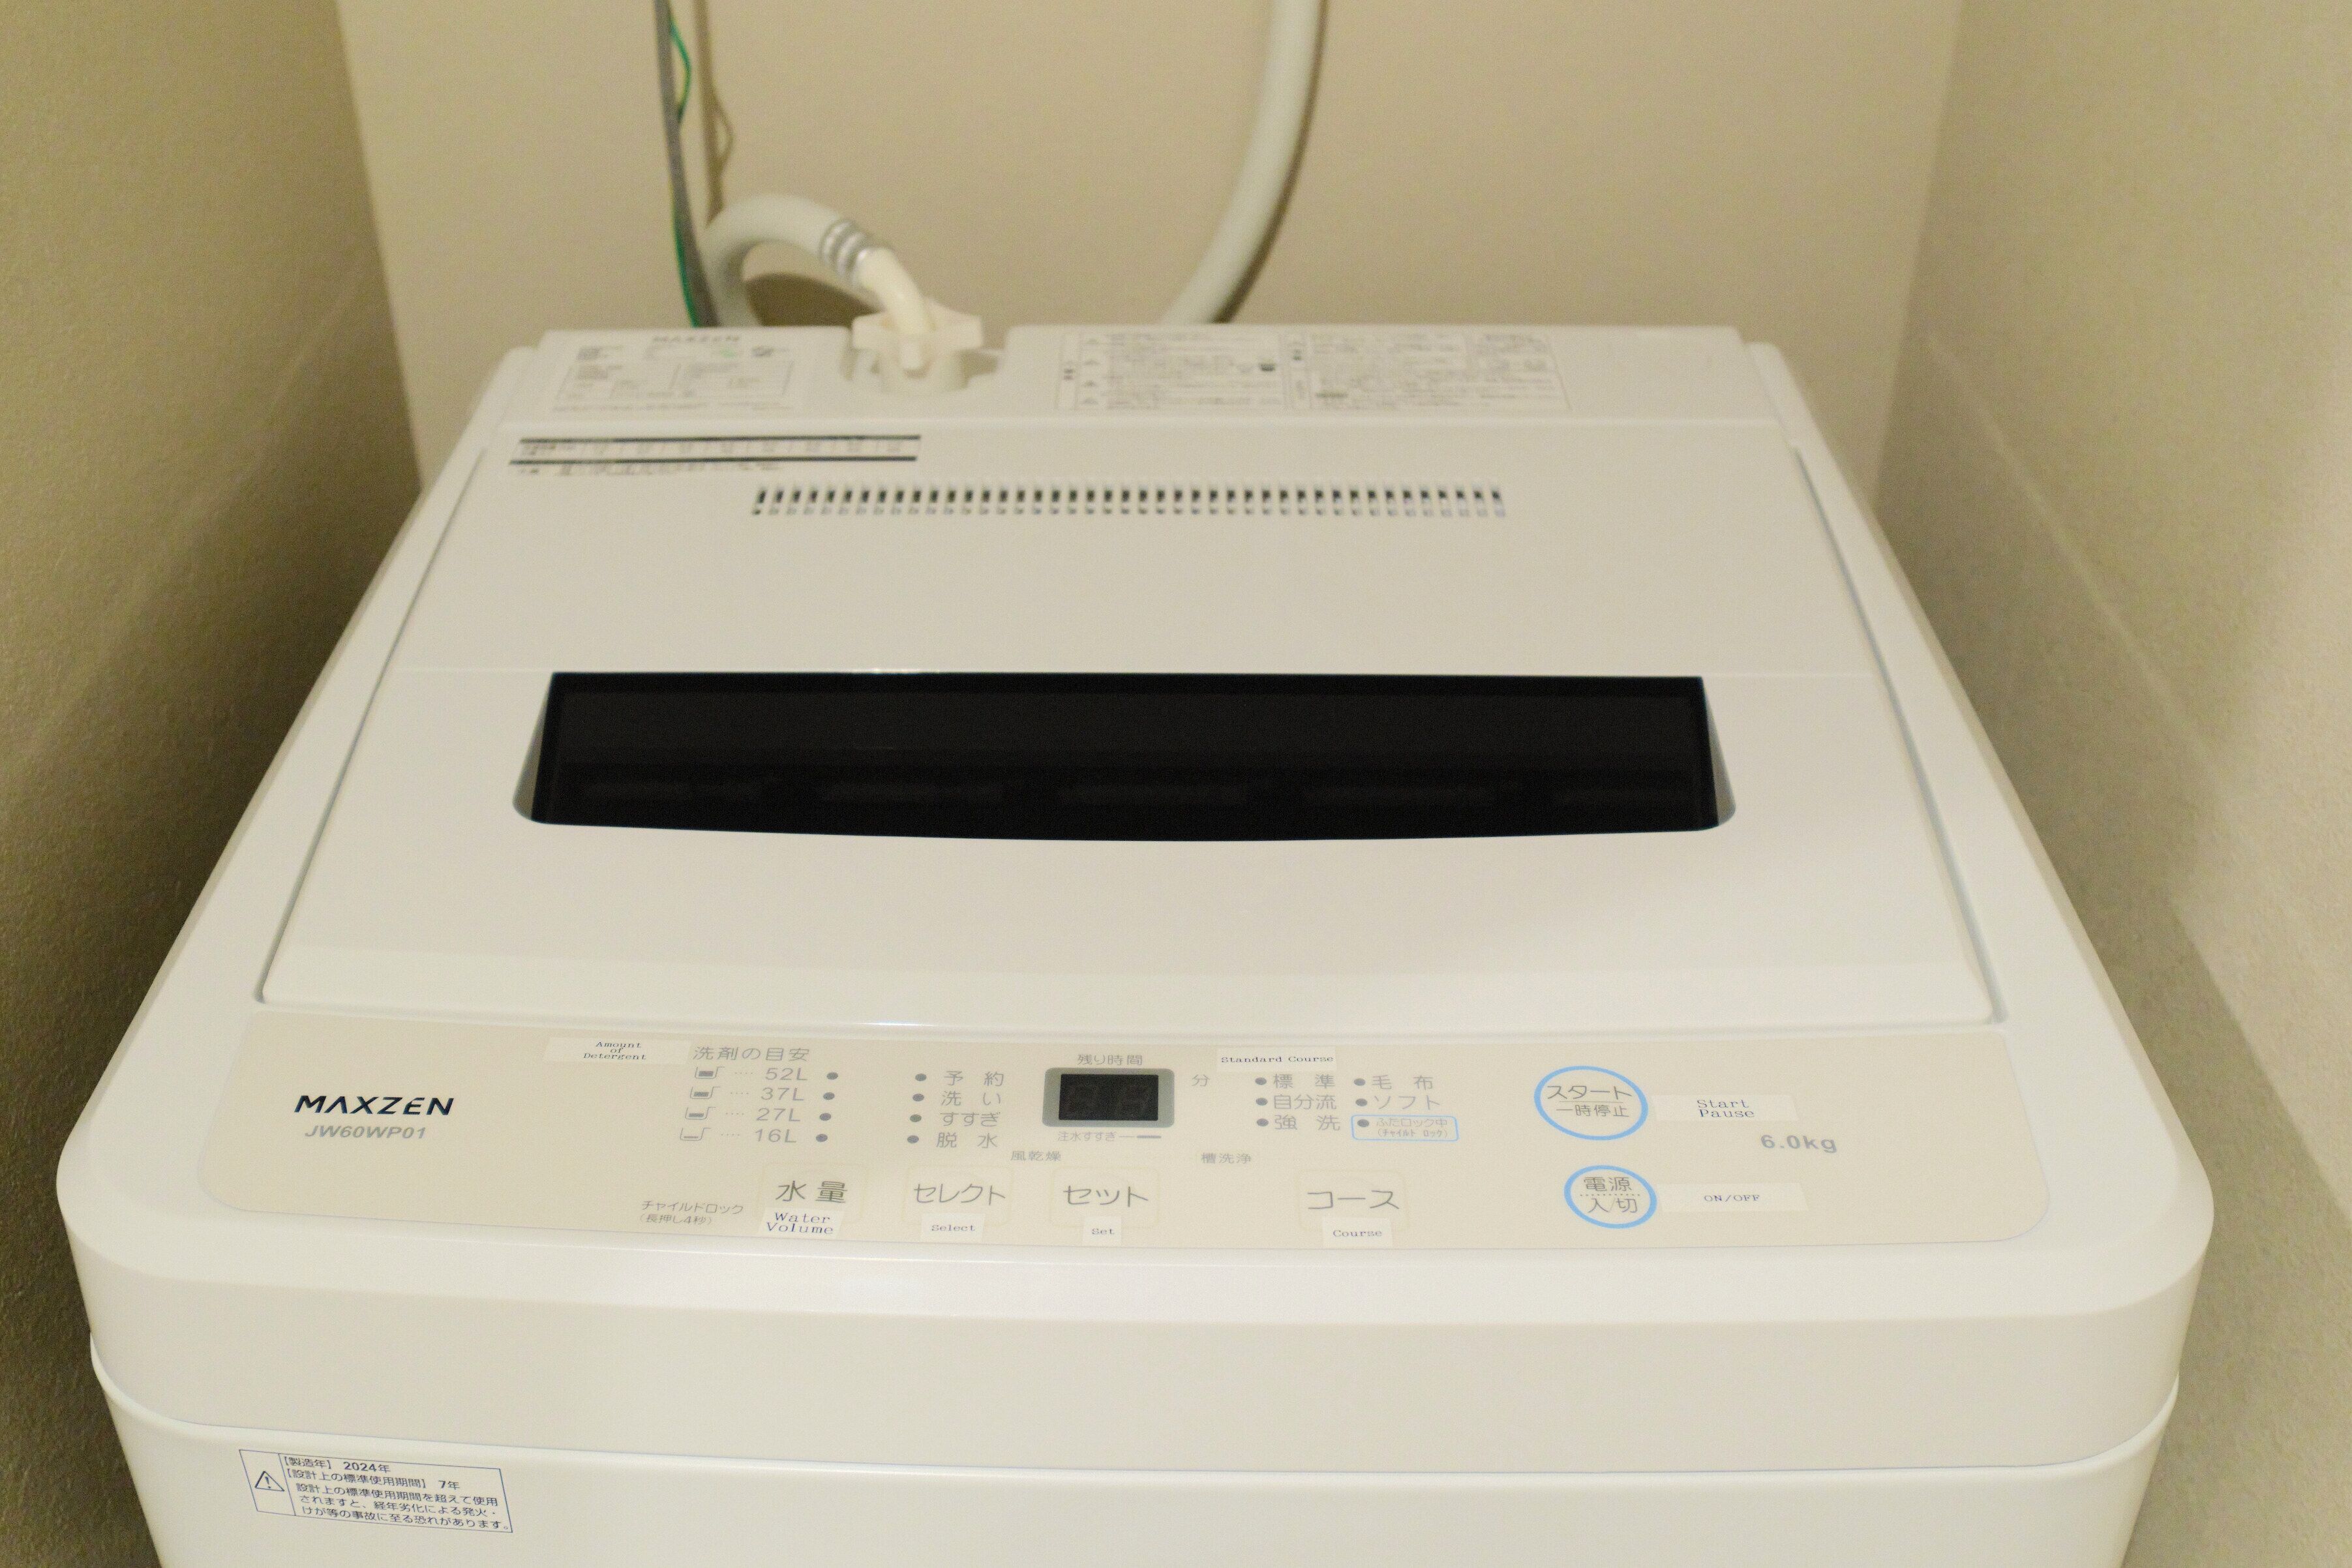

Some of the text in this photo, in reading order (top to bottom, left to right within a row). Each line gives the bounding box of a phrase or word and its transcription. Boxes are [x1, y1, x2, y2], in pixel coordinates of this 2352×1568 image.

[693, 1046, 810, 1062] 洗剤の目安
[1078, 1054, 1143, 1065] 残り時間
[765, 1068, 809, 1081] 52L
[1192, 1074, 1209, 1087] 分
[760, 1087, 805, 1101] 37L
[1546, 1085, 1632, 1100] スタート
[294, 1094, 454, 1115] MAXZEN
[1273, 1094, 1337, 1109] 自分流
[1373, 1095, 1440, 1109] ソフト
[1697, 1099, 1749, 1108] Start
[756, 1108, 802, 1122] 27L
[1556, 1104, 1629, 1117] 一時停止
[1698, 1109, 1755, 1119] Pause
[941, 1111, 1000, 1126] すすぎ
[1376, 1118, 1447, 1127] ふたロック中
[305, 1124, 426, 1139] JW60WP01
[753, 1129, 798, 1143] 16L
[1057, 1131, 1117, 1141] 注水すすぎ
[1760, 1135, 1837, 1153] 6.0kg
[1010, 1150, 1062, 1162] 風乾燥
[1201, 1153, 1252, 1164] 槽洗浄
[1583, 1176, 1632, 1192] 電源
[914, 1183, 1006, 1205] セレクト
[1063, 1184, 1148, 1207] セット
[1307, 1190, 1400, 1211] コース
[1704, 1194, 1760, 1203] ON/OFF
[642, 1200, 743, 1214] チャイルドロック
[774, 1211, 830, 1224] Water
[766, 1222, 834, 1234] Volume
[931, 1223, 975, 1231] Select
[1091, 1226, 1115, 1235] Set
[344, 1462, 391, 1473] 2024年
[438, 1480, 460, 1490] 7年
